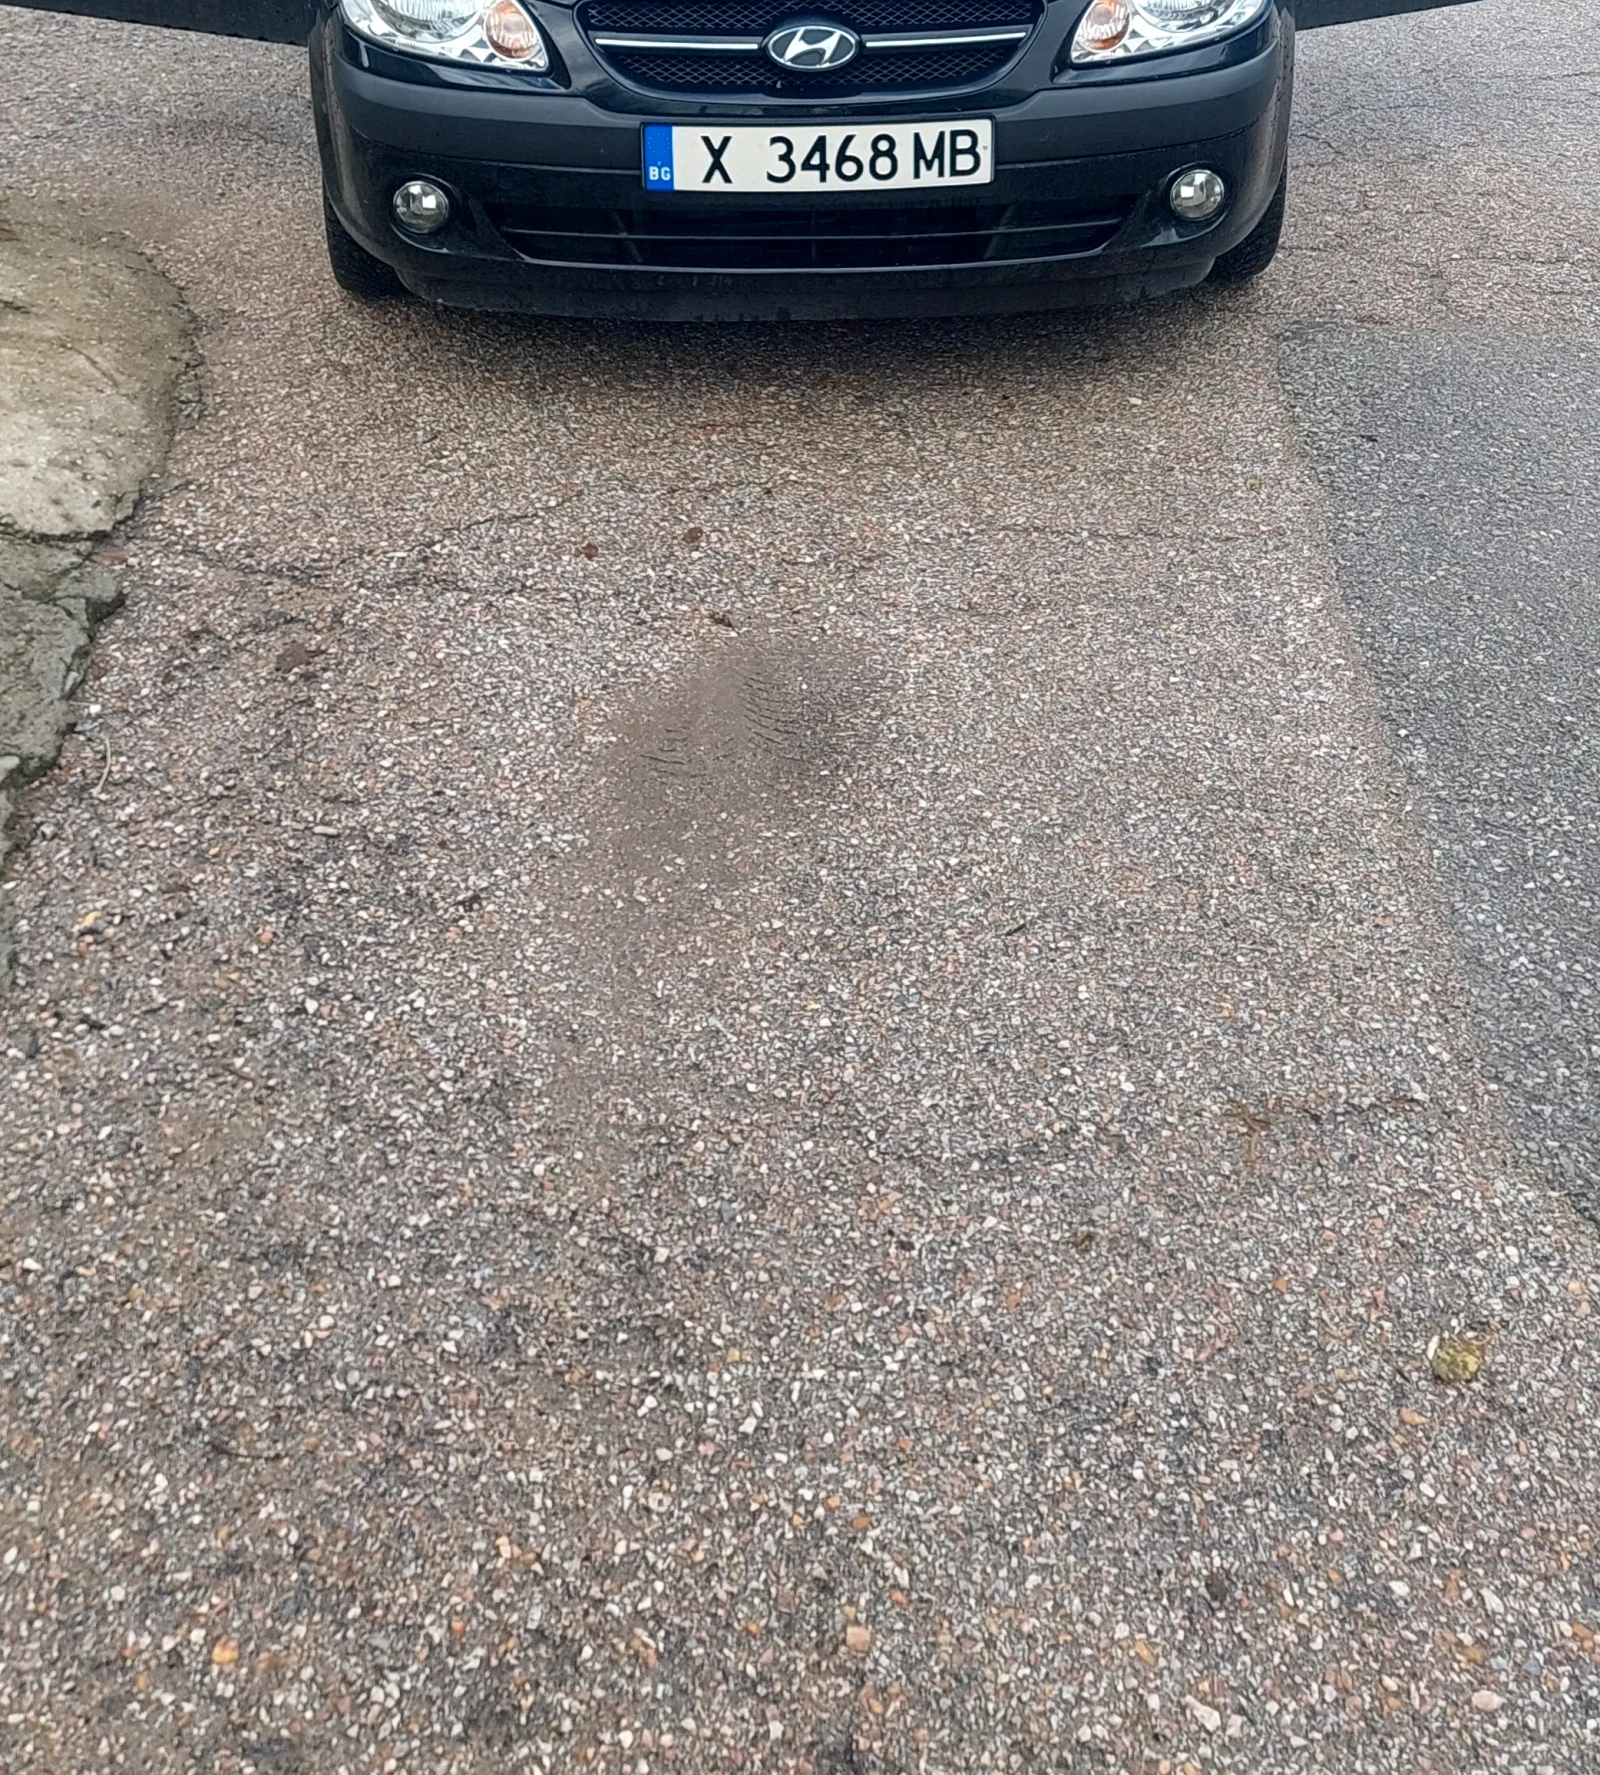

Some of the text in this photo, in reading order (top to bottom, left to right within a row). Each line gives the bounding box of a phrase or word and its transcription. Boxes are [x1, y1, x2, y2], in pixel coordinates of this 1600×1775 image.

[648, 166, 671, 181] BG
[700, 129, 981, 184] X 3468 MB
